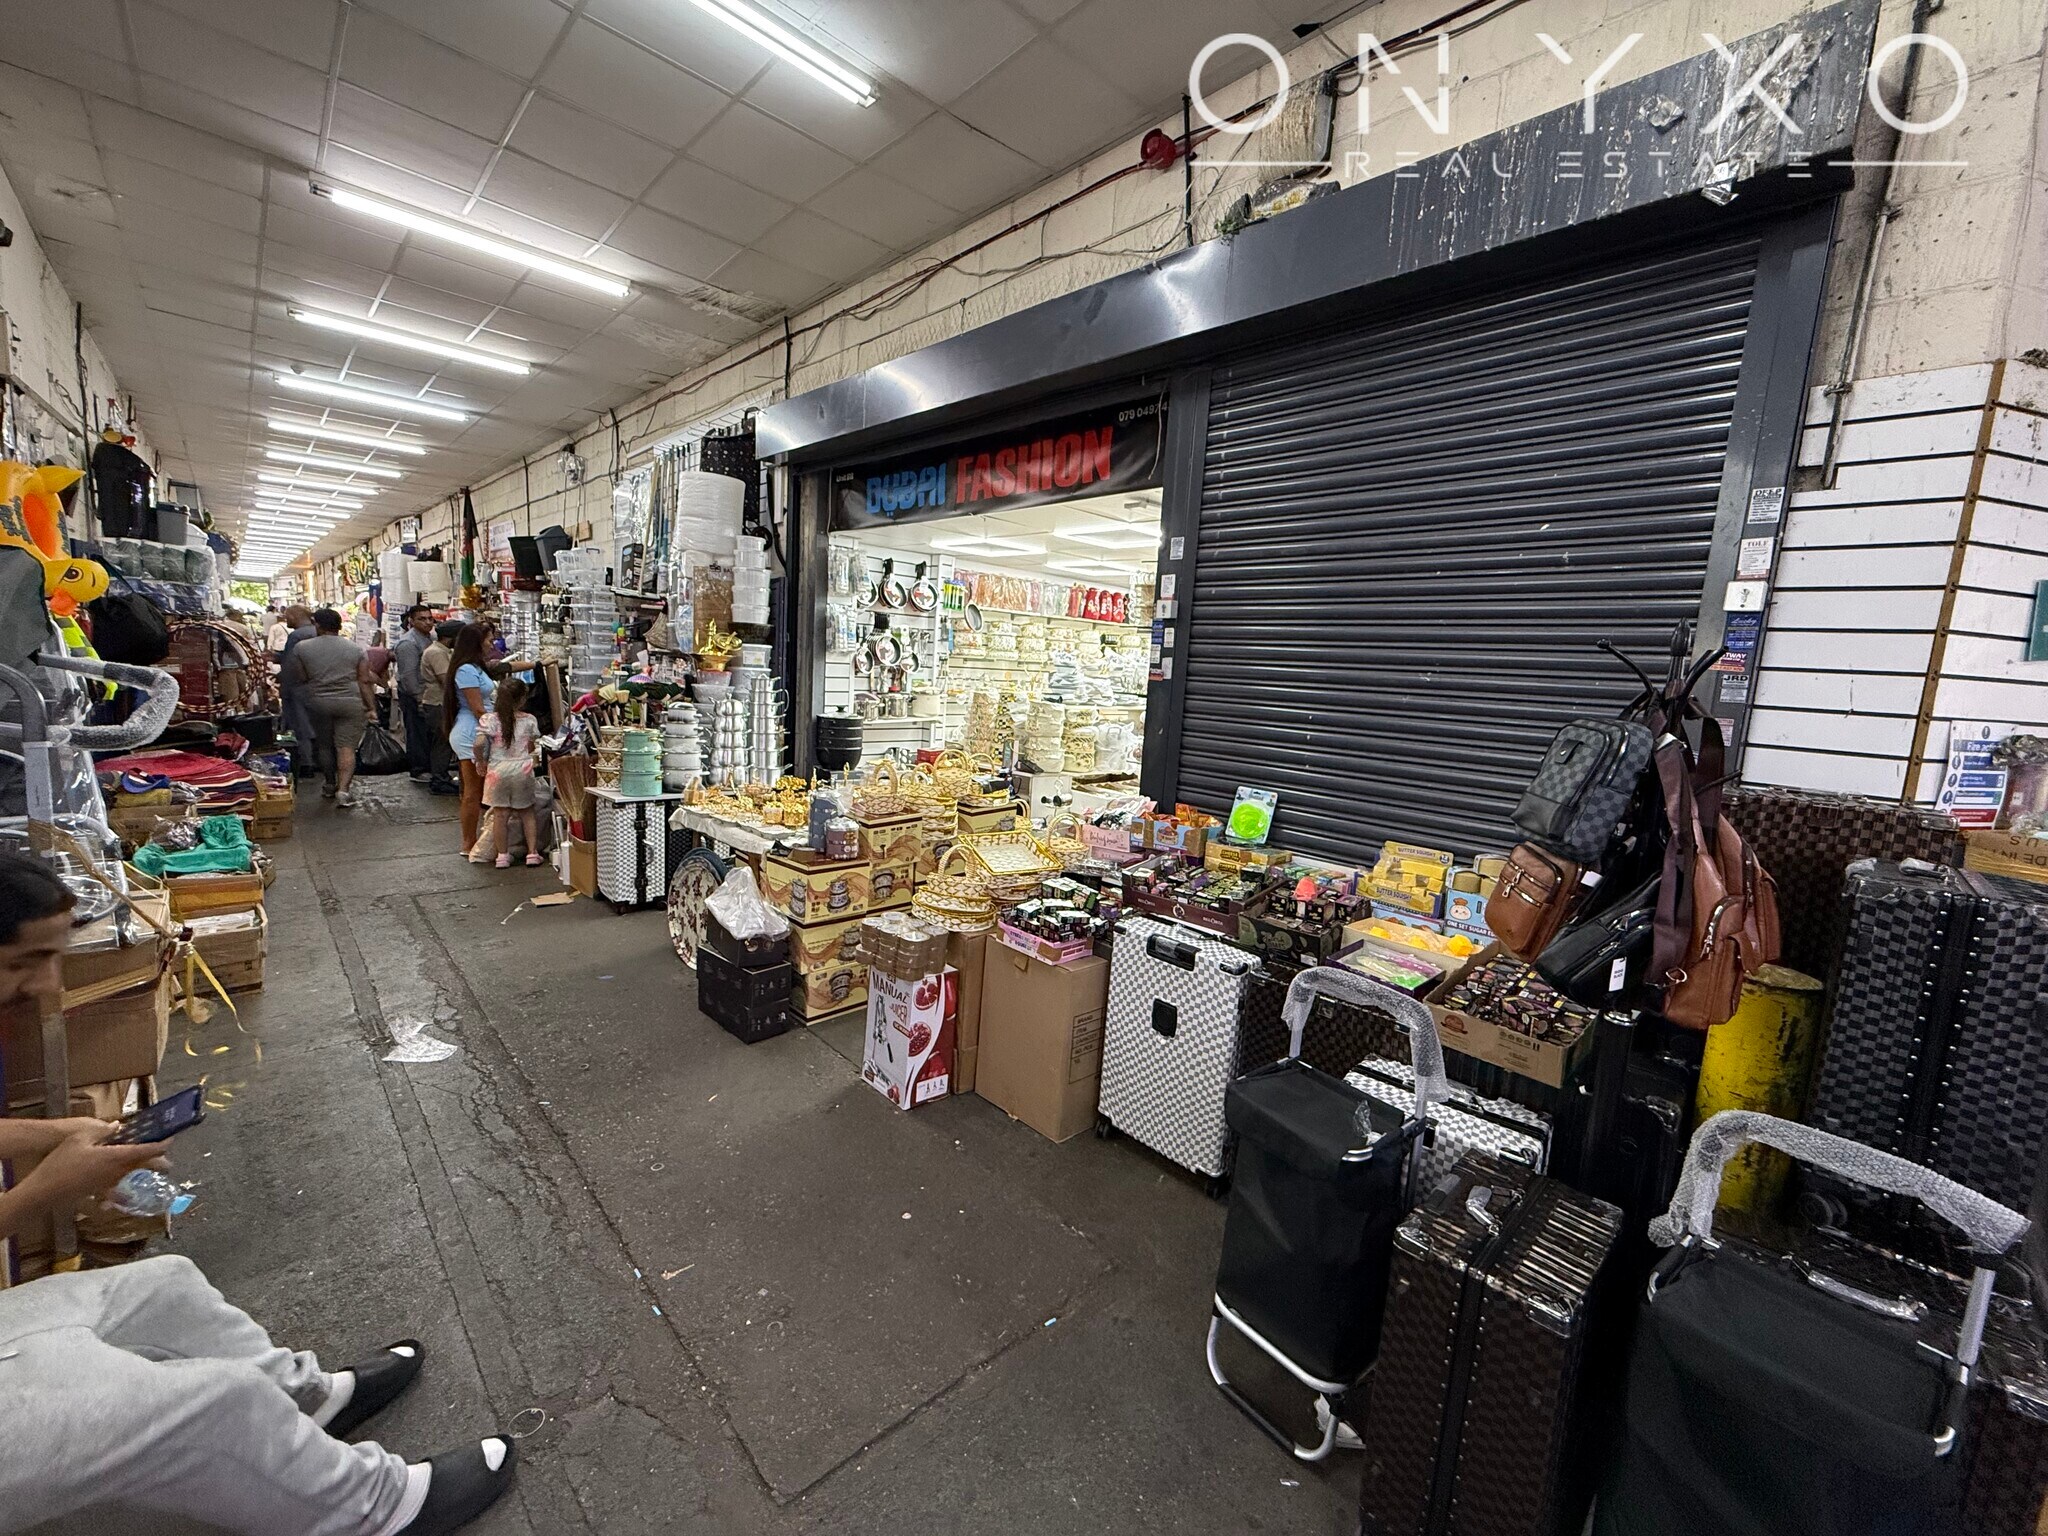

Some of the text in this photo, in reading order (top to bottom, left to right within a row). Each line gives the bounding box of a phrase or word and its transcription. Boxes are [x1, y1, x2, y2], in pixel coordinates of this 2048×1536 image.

[1119, 409, 1135, 422] 079
[866, 426, 1113, 517] DUBAI FASHION
[1967, 742, 1981, 750] Fire
[1469, 926, 1487, 935] SUGAR
[873, 971, 907, 1004] MANUAL
[889, 1003, 907, 1026] JUICER
